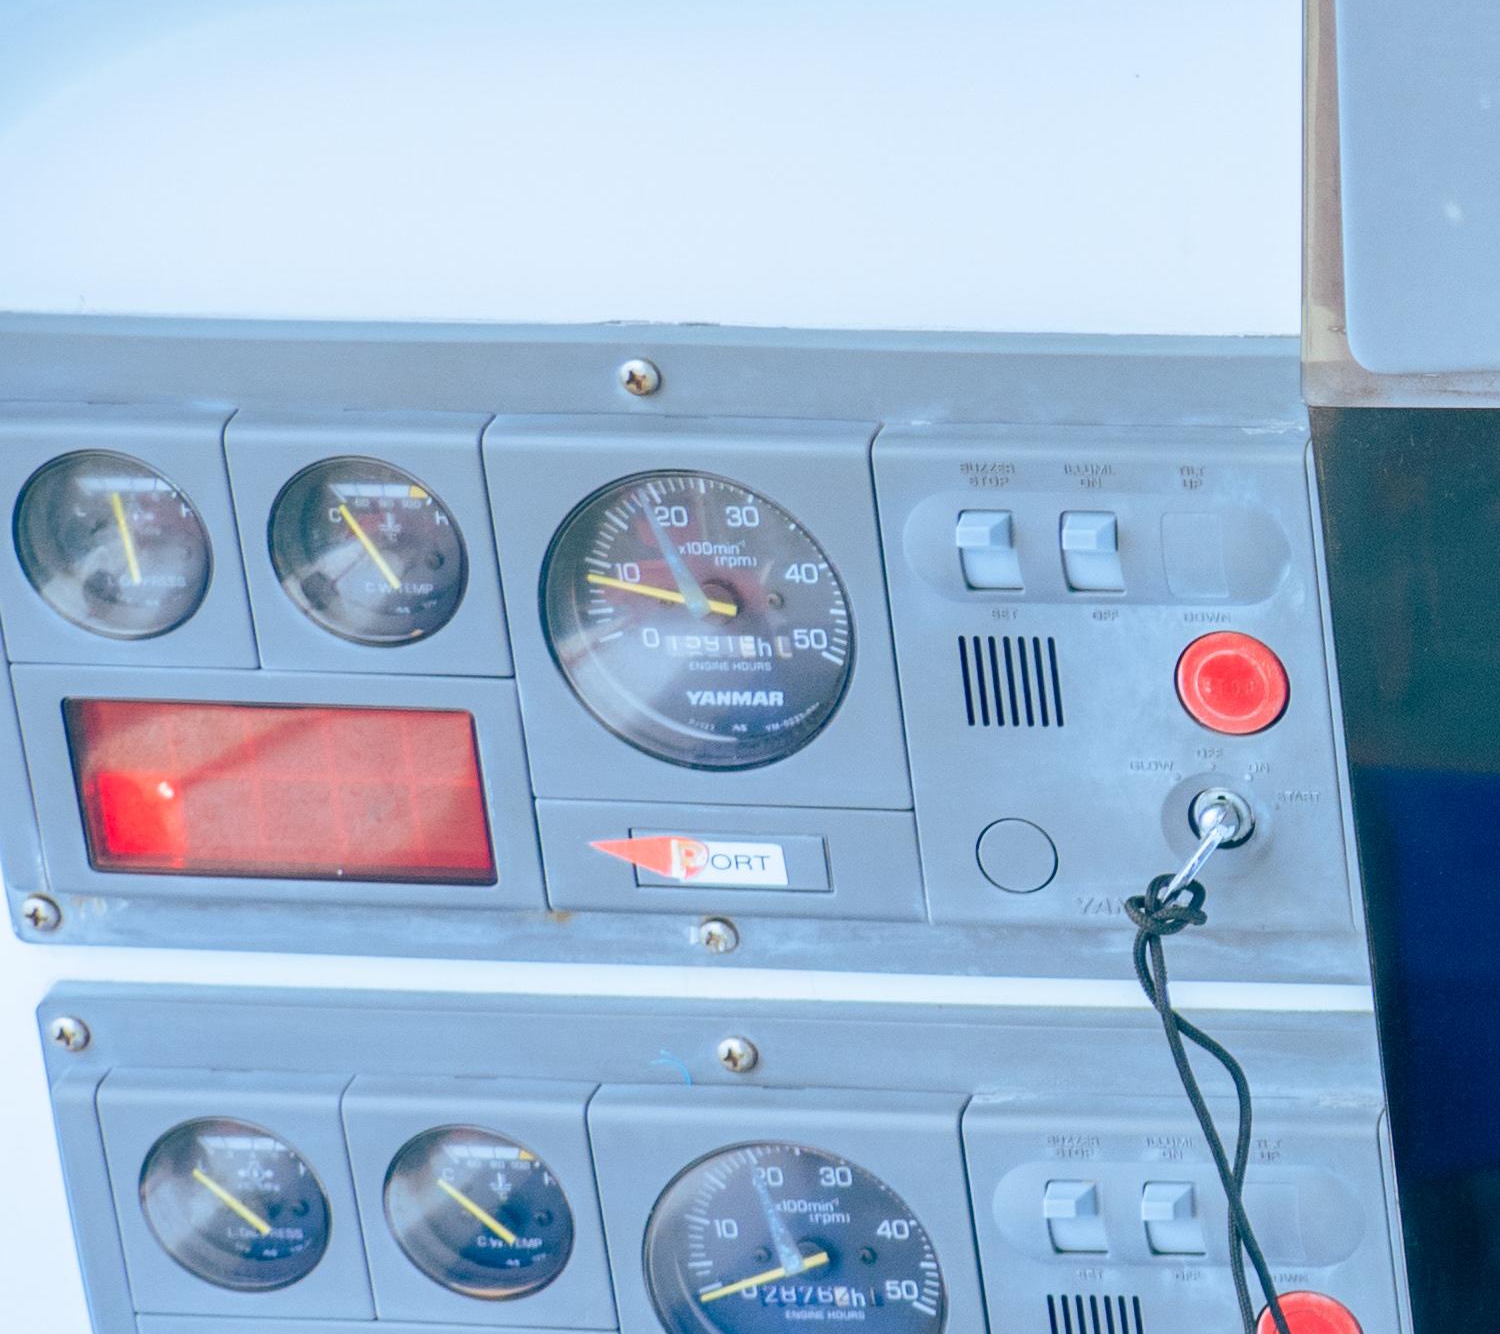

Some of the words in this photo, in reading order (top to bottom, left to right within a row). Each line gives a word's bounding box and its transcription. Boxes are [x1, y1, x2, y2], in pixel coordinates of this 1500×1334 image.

[654, 505, 689, 528] 20
[725, 506, 760, 528] 30
[614, 562, 641, 584] 10
[784, 563, 819, 584] 40
[642, 627, 661, 650] 0
[792, 628, 828, 650] 50
[686, 690, 784, 707] YANMAR
[670, 838, 771, 878] PORT
[820, 1166, 853, 1188] 30
[714, 1218, 739, 1240] 10
[876, 1219, 910, 1240] 40
[884, 1279, 919, 1301] 50
